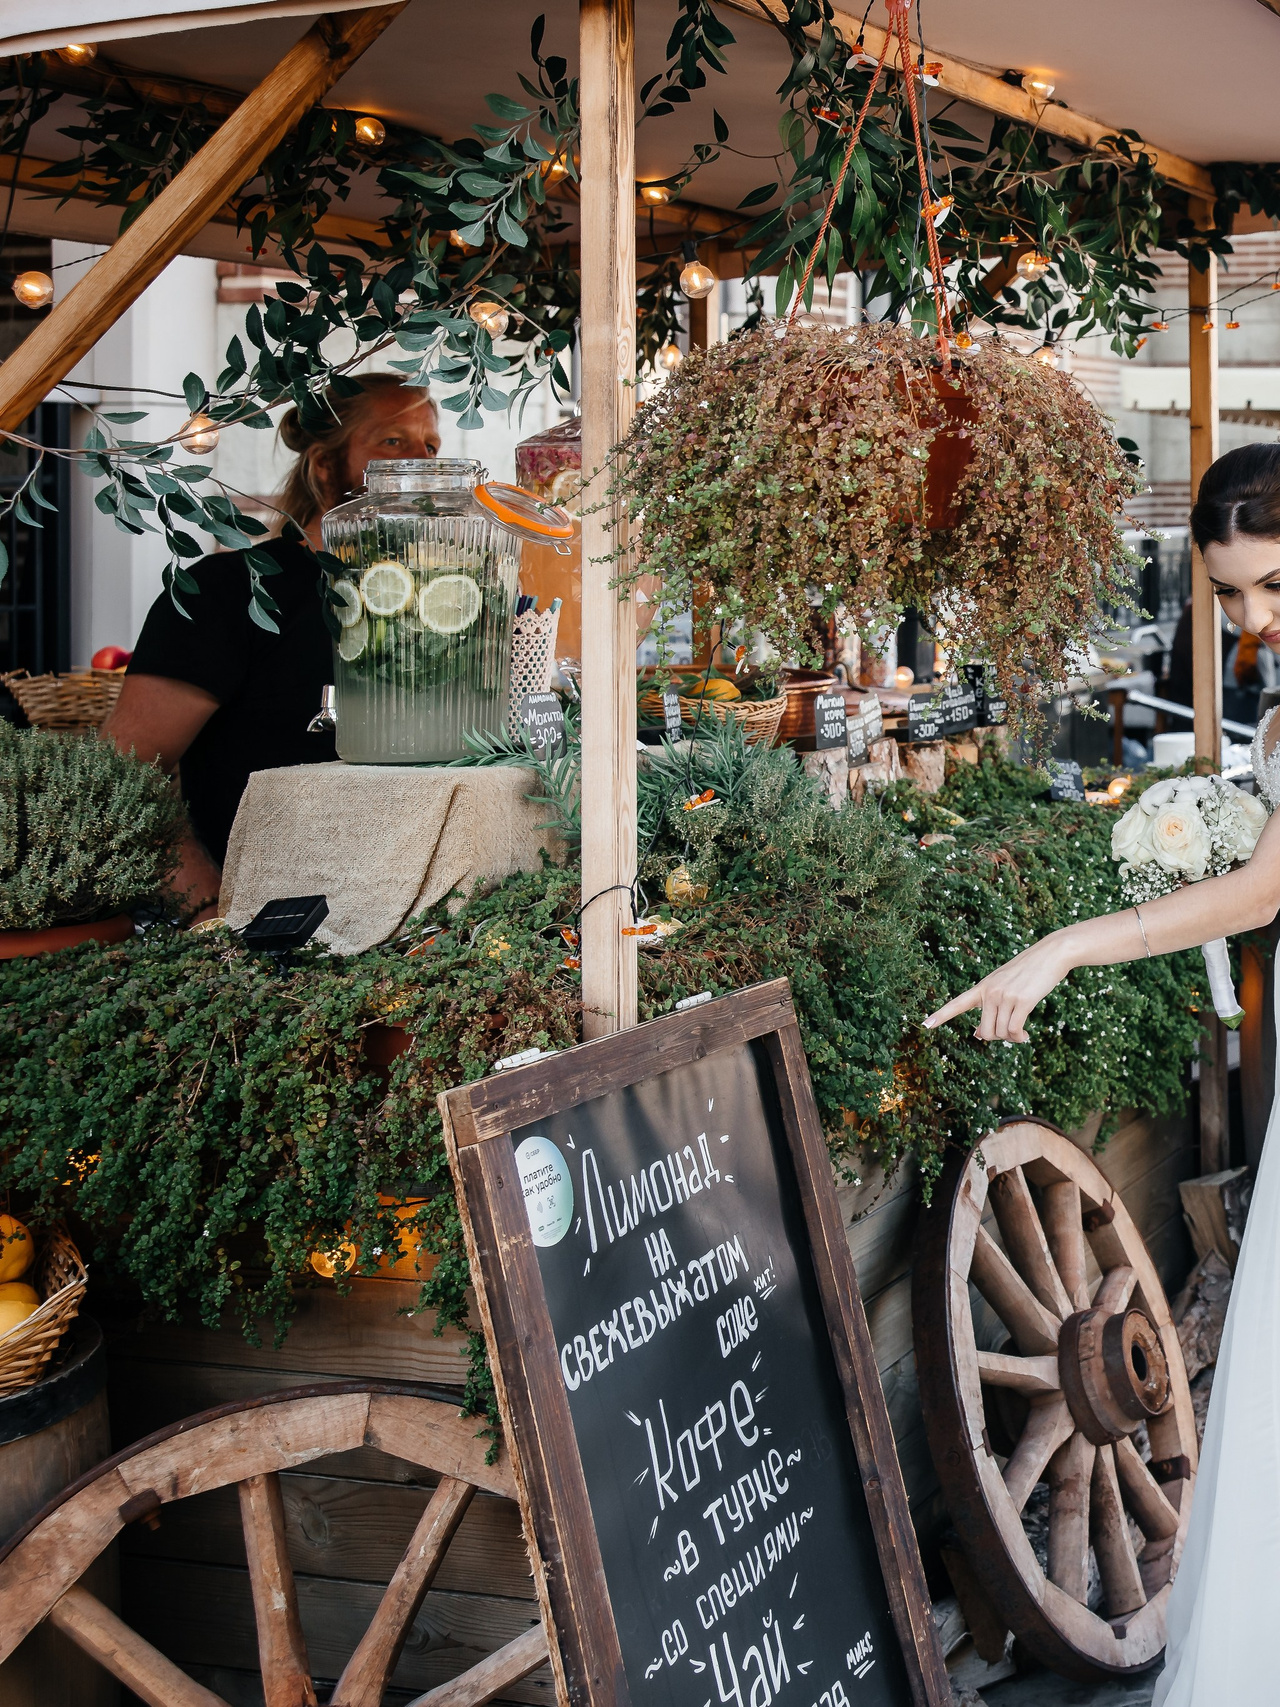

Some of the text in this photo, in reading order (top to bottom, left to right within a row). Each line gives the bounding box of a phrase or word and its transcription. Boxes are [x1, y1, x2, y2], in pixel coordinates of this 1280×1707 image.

[823, 722, 842, 739] 300
[522, 1173, 562, 1198] ак удобно
[523, 1164, 554, 1184] платите
[582, 1131, 721, 1254] Лимонад
[644, 1379, 760, 1510] Кофе
[709, 1608, 791, 1707] Чай
